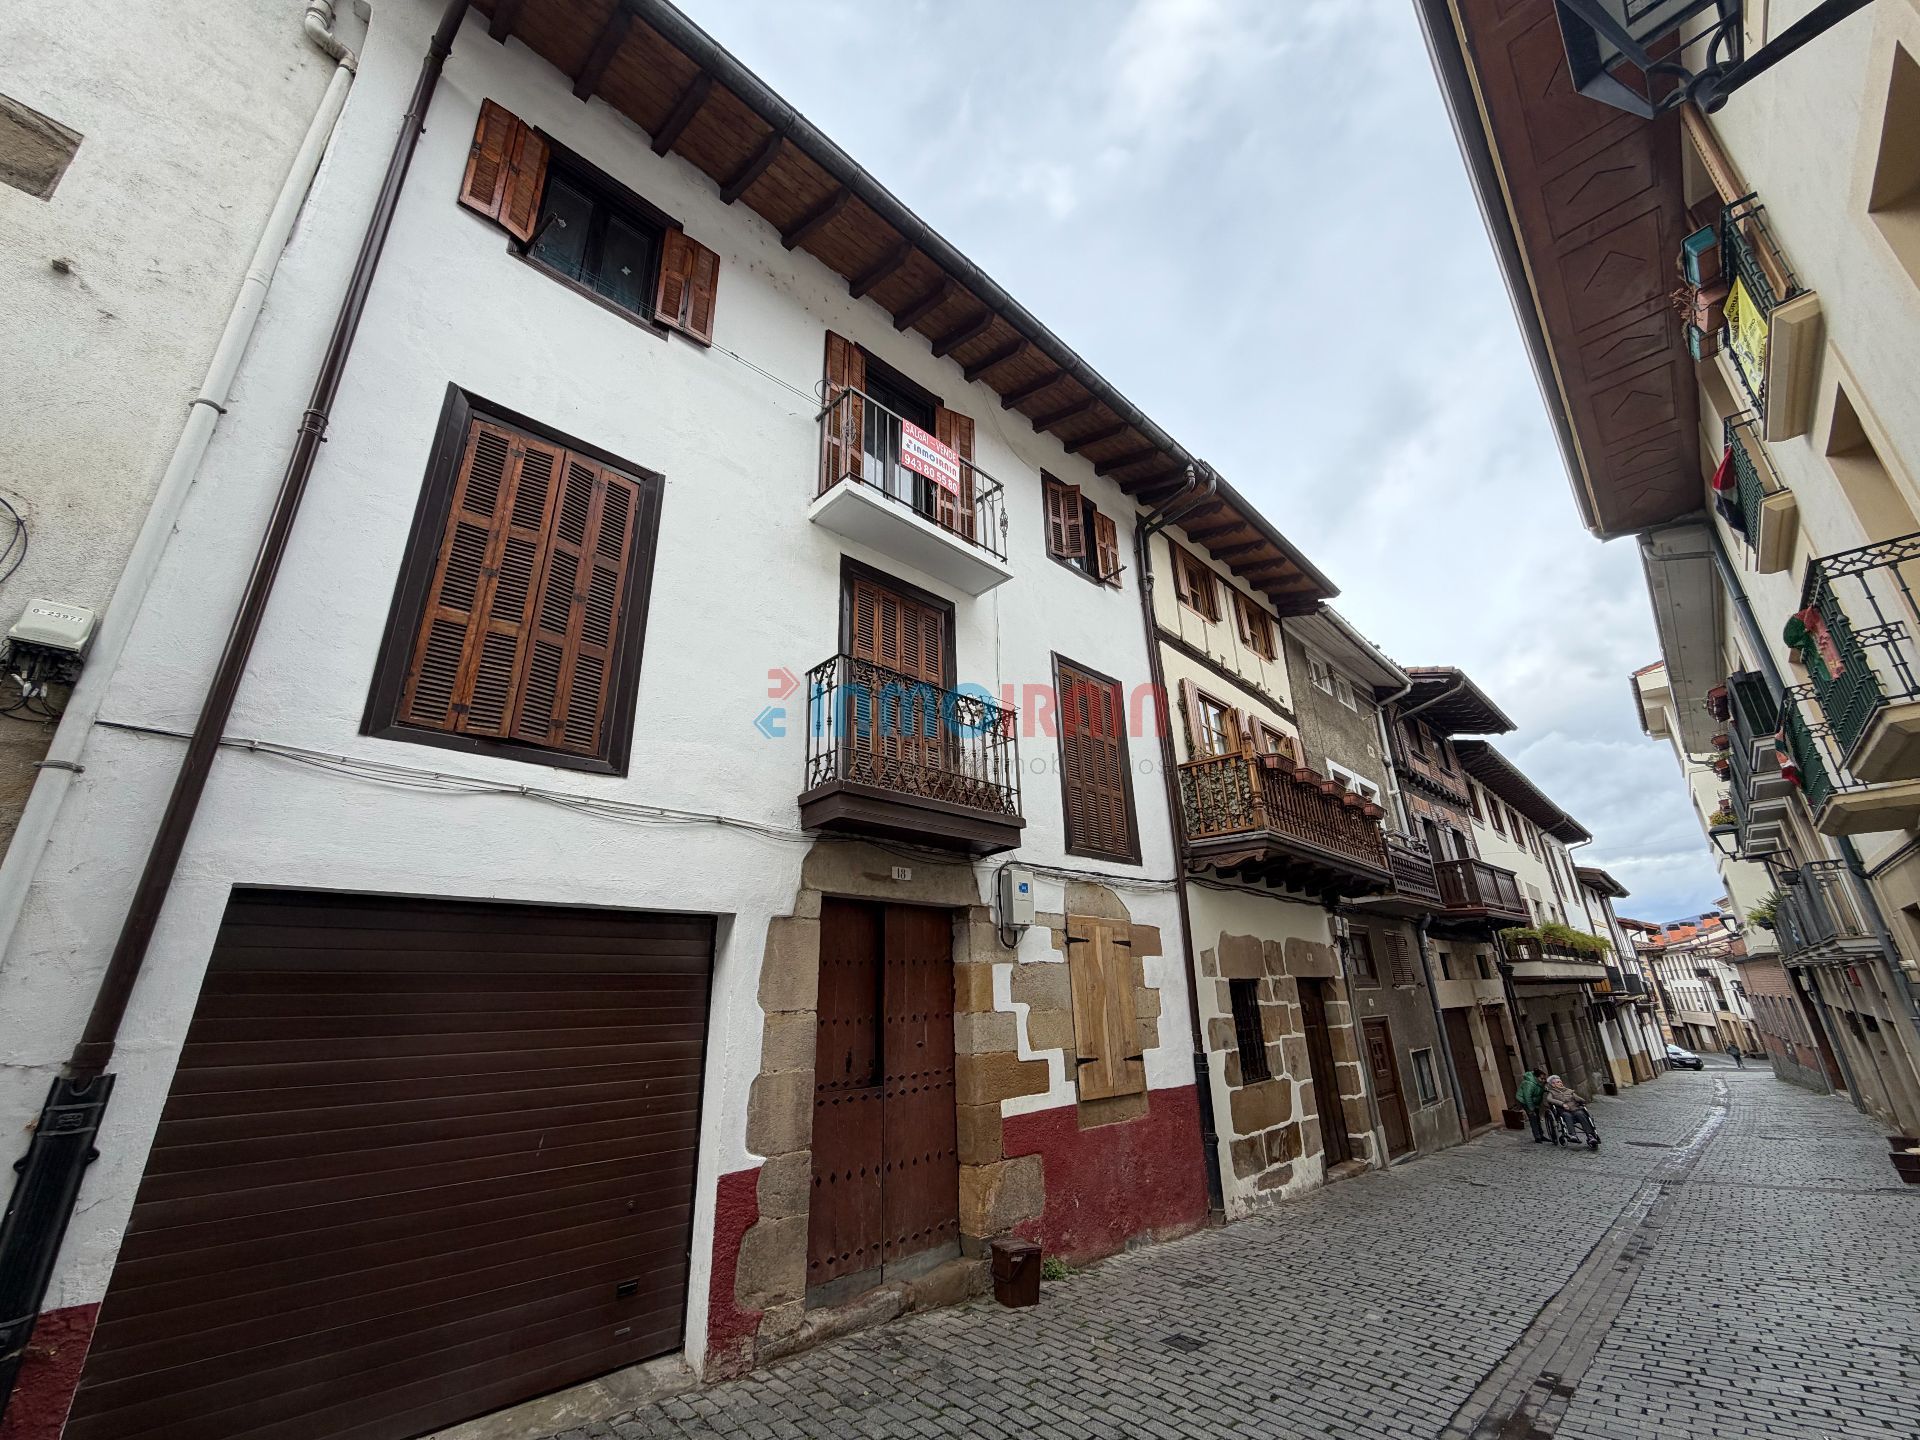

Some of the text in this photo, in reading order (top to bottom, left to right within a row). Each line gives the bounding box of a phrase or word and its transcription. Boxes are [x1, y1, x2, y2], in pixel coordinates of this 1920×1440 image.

[905, 422, 929, 446] SALGAI
[936, 443, 957, 463] VENDE
[904, 454, 957, 493] 943 80 55 80
